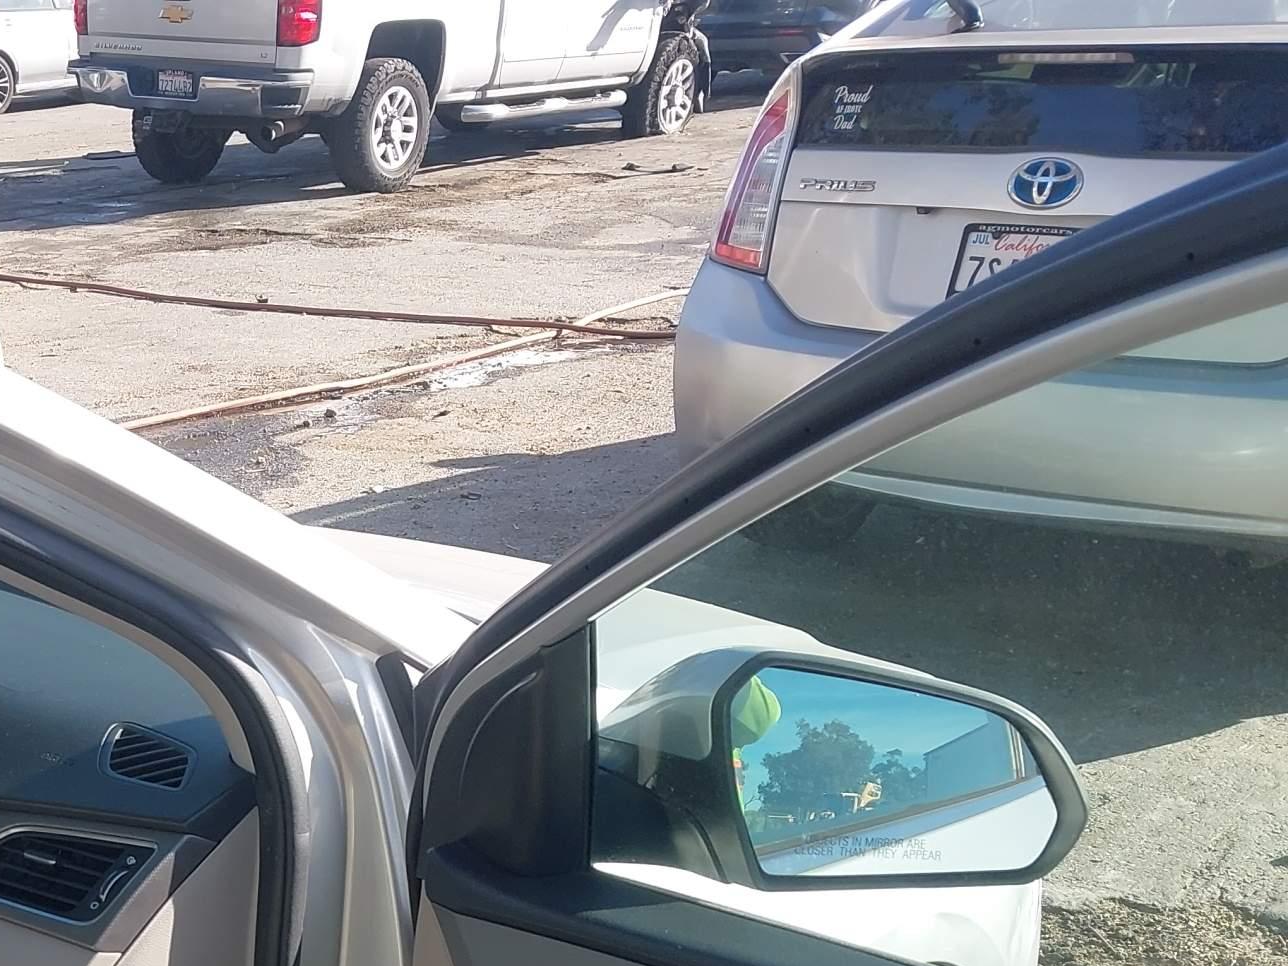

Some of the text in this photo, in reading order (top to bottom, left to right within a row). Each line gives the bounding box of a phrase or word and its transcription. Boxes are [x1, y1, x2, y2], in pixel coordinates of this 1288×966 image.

[834, 84, 874, 104] Proud
[833, 114, 857, 130] Dad
[799, 177, 877, 192] PRIUS
[972, 233, 990, 246] JUL
[994, 234, 1050, 257] Califo
[851, 836, 862, 847] IN
[864, 837, 904, 849] MIRROR
[906, 839, 927, 850] ARE
[840, 846, 866, 857] THAN
[872, 847, 897, 860] THEY
[903, 849, 942, 861] APPEAR
